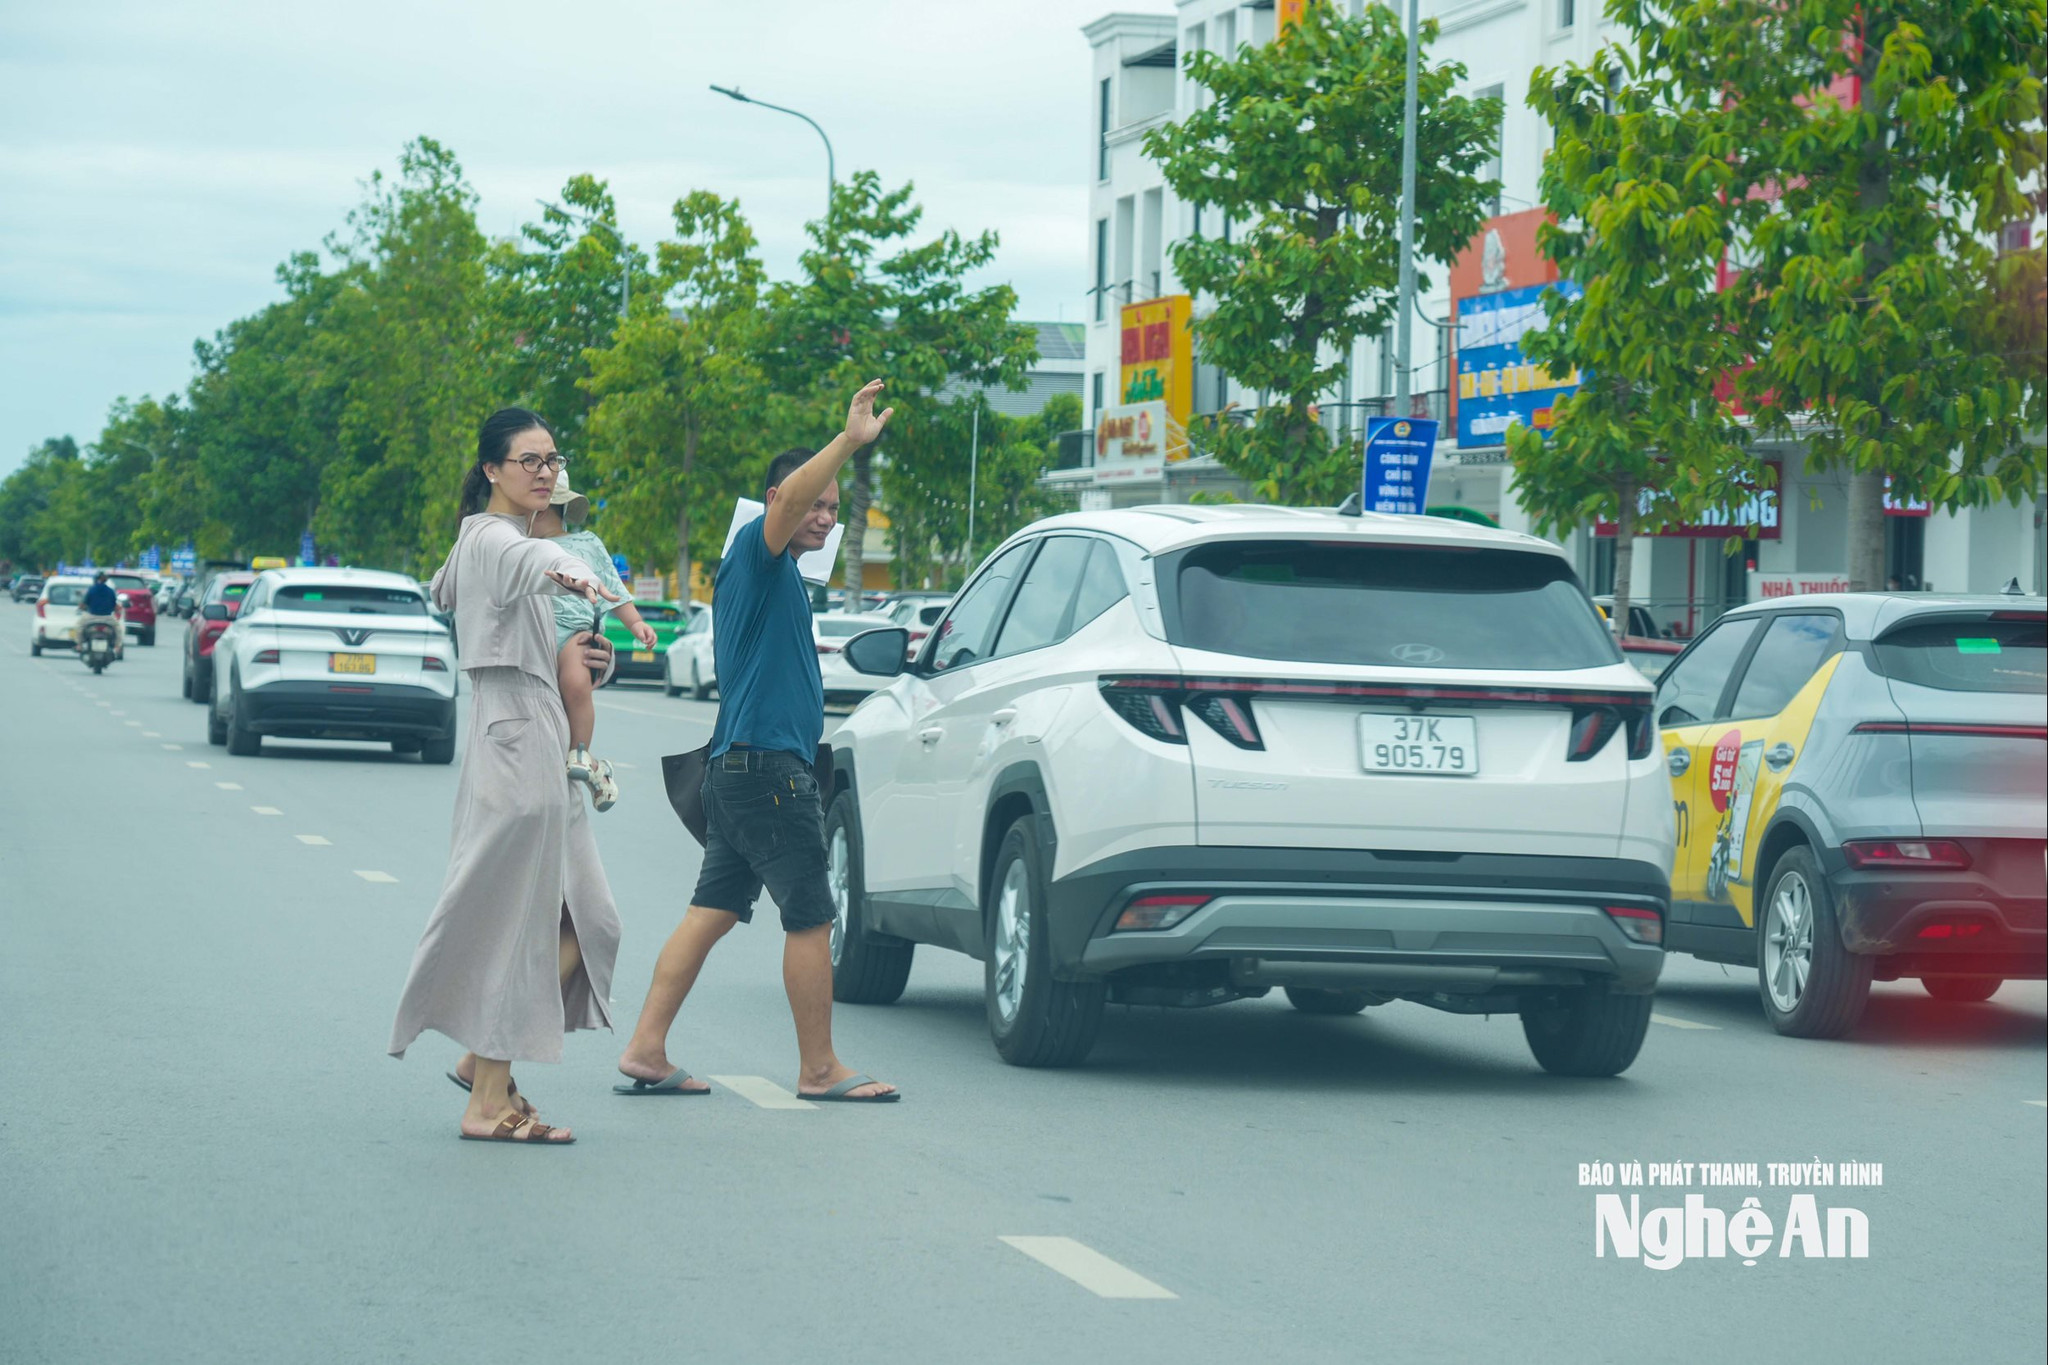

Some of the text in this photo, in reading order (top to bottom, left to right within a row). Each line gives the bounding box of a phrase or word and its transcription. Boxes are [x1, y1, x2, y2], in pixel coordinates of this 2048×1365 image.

[1762, 577, 1794, 597] NHÀ
[1394, 717, 1441, 742] 37K
[1375, 743, 1465, 770] 905.79
